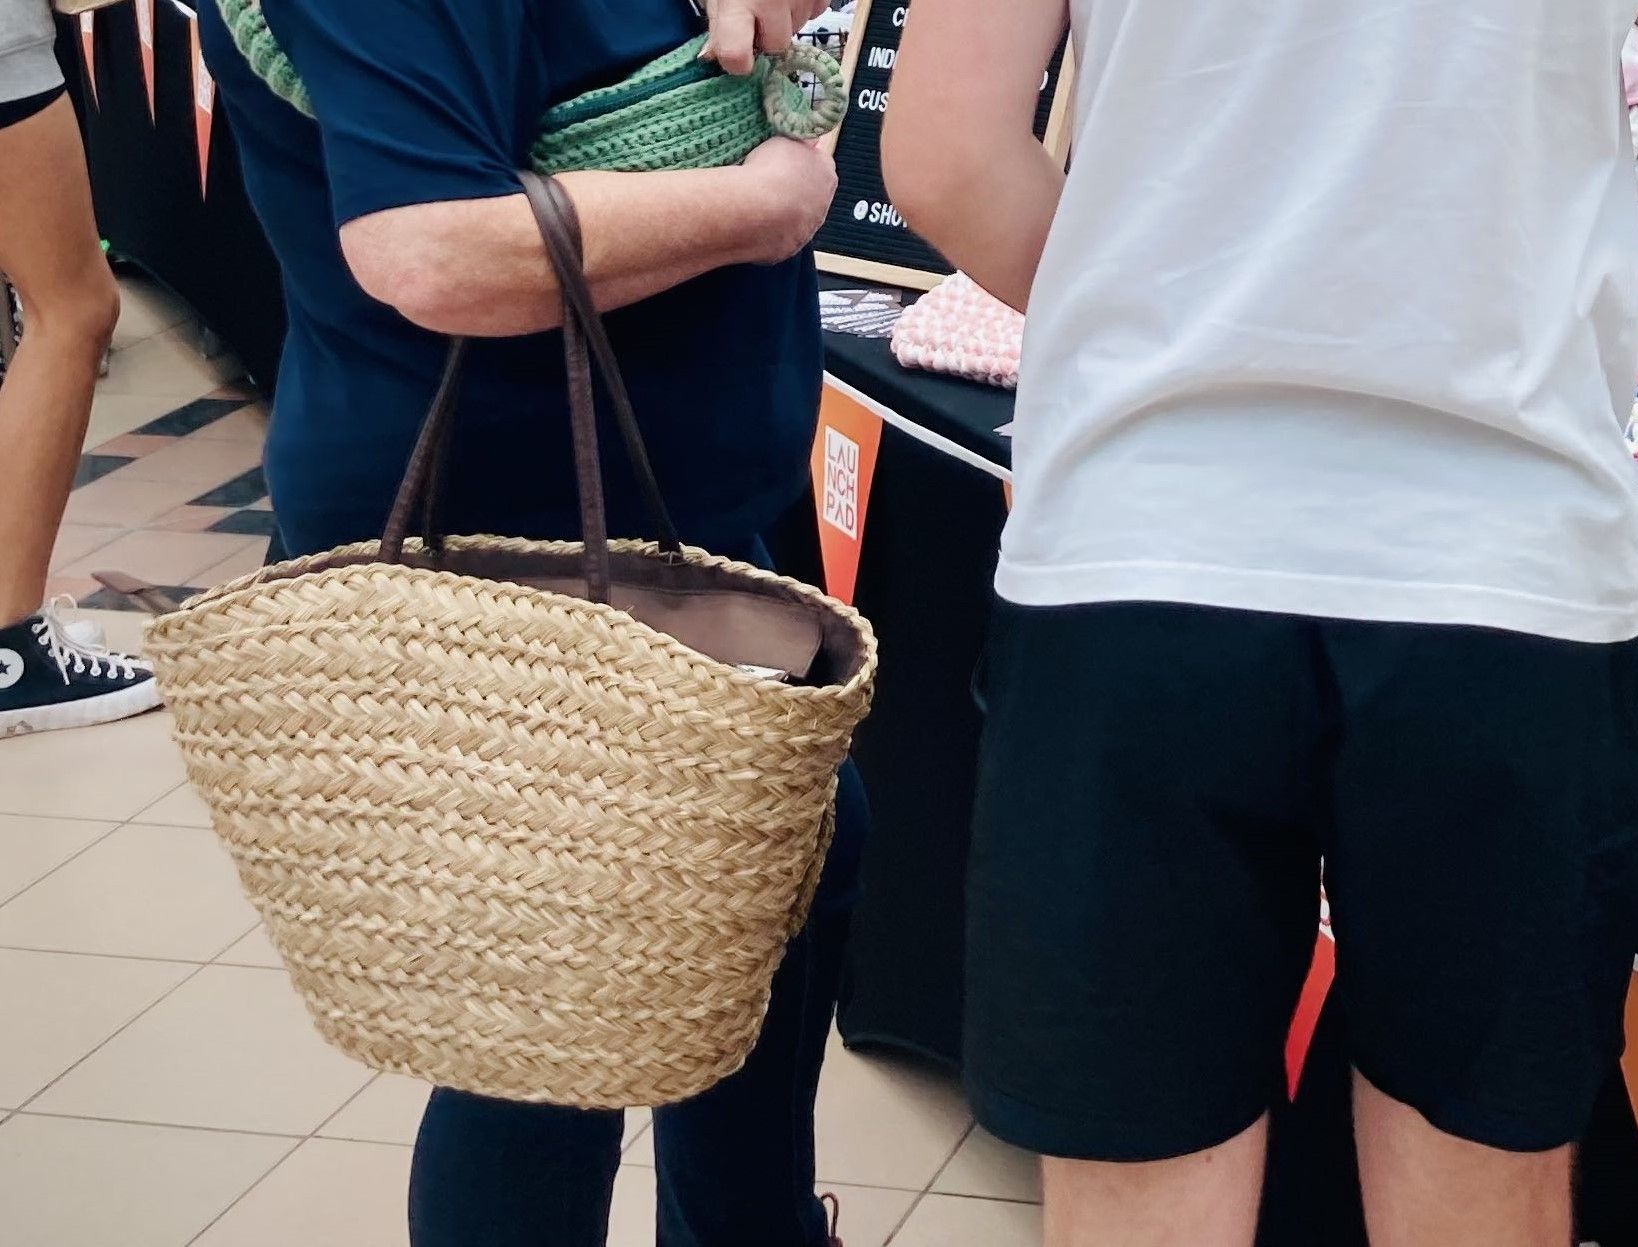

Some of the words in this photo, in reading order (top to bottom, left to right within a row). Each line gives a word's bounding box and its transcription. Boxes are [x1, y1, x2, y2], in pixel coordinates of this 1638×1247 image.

[828, 433, 856, 474] LAU
[827, 462, 855, 504] NCH
[826, 490, 854, 531] PAD
